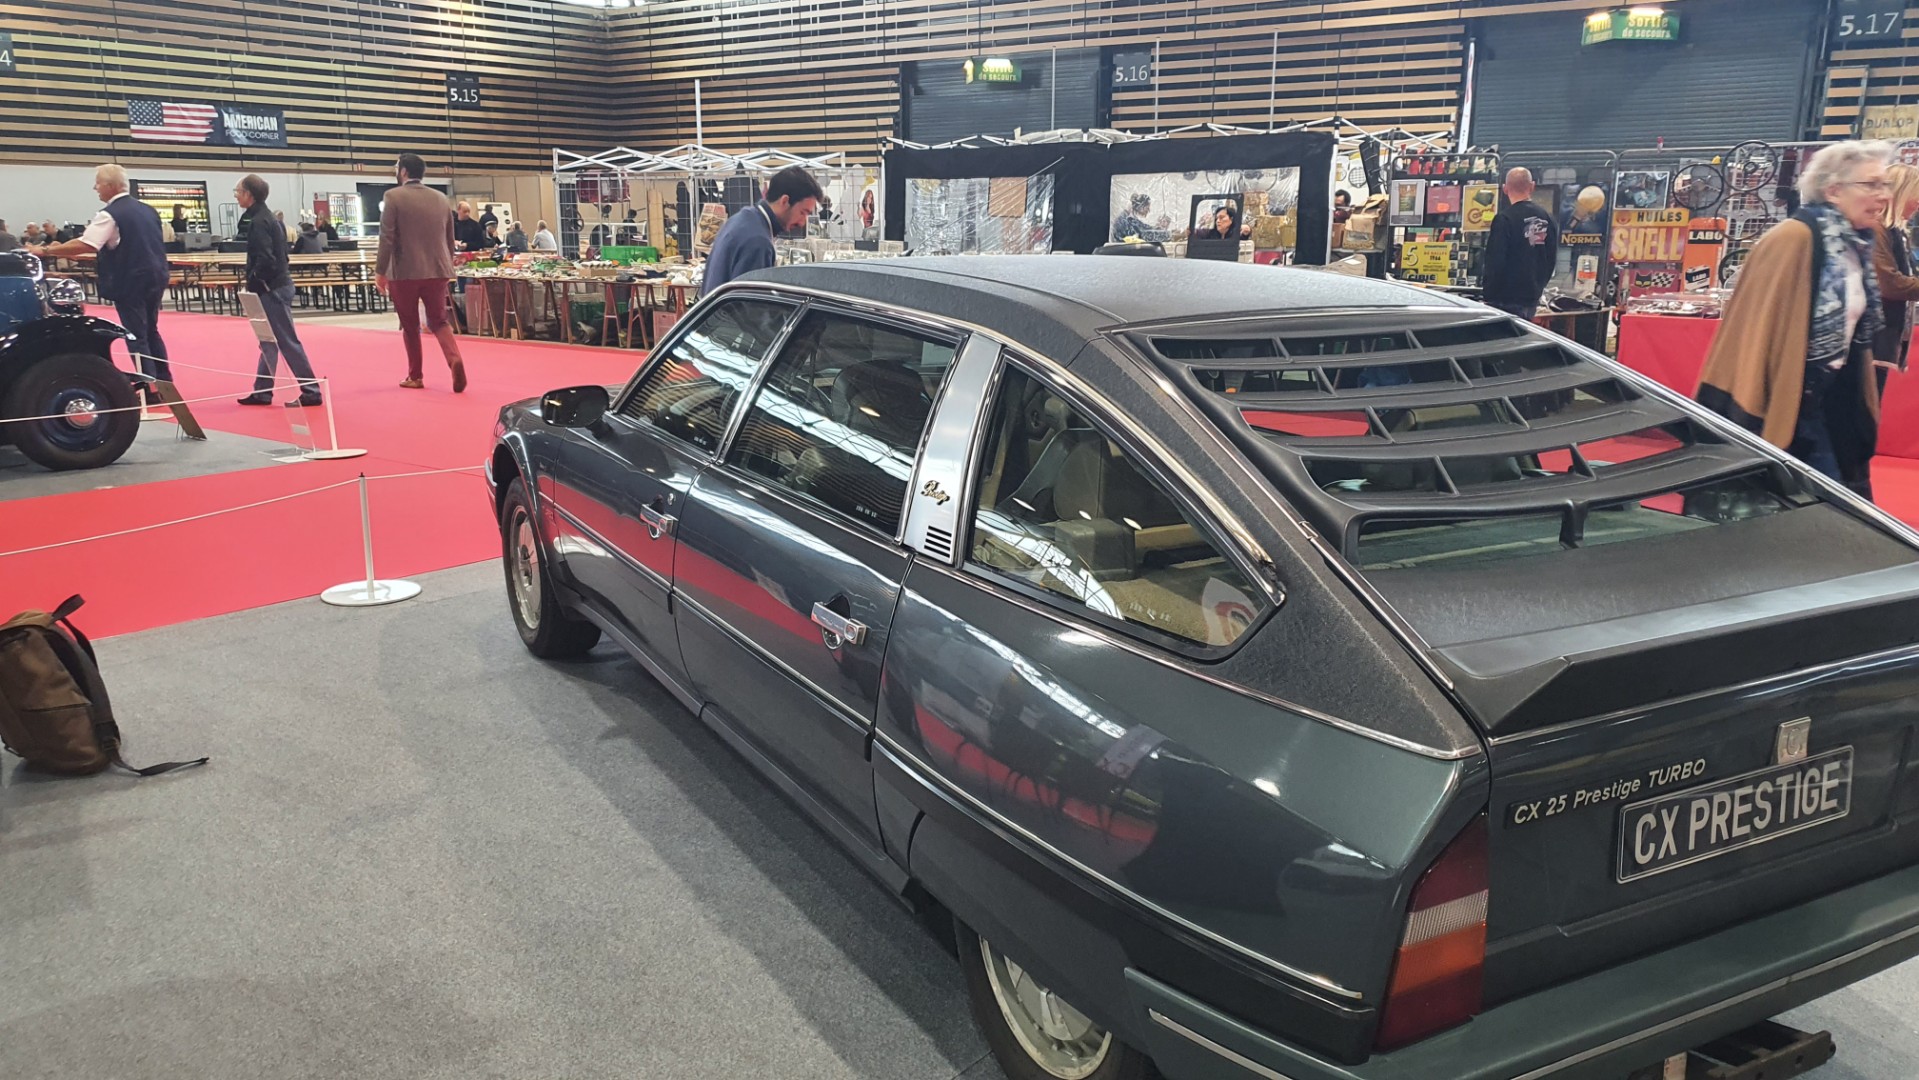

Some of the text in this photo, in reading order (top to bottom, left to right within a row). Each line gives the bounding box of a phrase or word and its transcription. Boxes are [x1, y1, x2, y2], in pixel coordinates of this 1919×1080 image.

[1628, 14, 1669, 28] Sortie
[1839, 11, 1900, 37] 5.17
[1621, 27, 1634, 38] de
[1635, 28, 1672, 39] secours
[1115, 64, 1148, 82] 5.16
[450, 87, 478, 103] 5.15
[223, 113, 278, 131] AMERICAN
[225, 129, 279, 140] FOOD CORNER
[1637, 212, 1682, 222] HUILES
[1561, 233, 1602, 244] NORMA
[1611, 227, 1682, 261] SHELL
[1514, 758, 1706, 824] CX 25 Prestige TURBO
[1634, 761, 1841, 865] CX PRESTIGE
